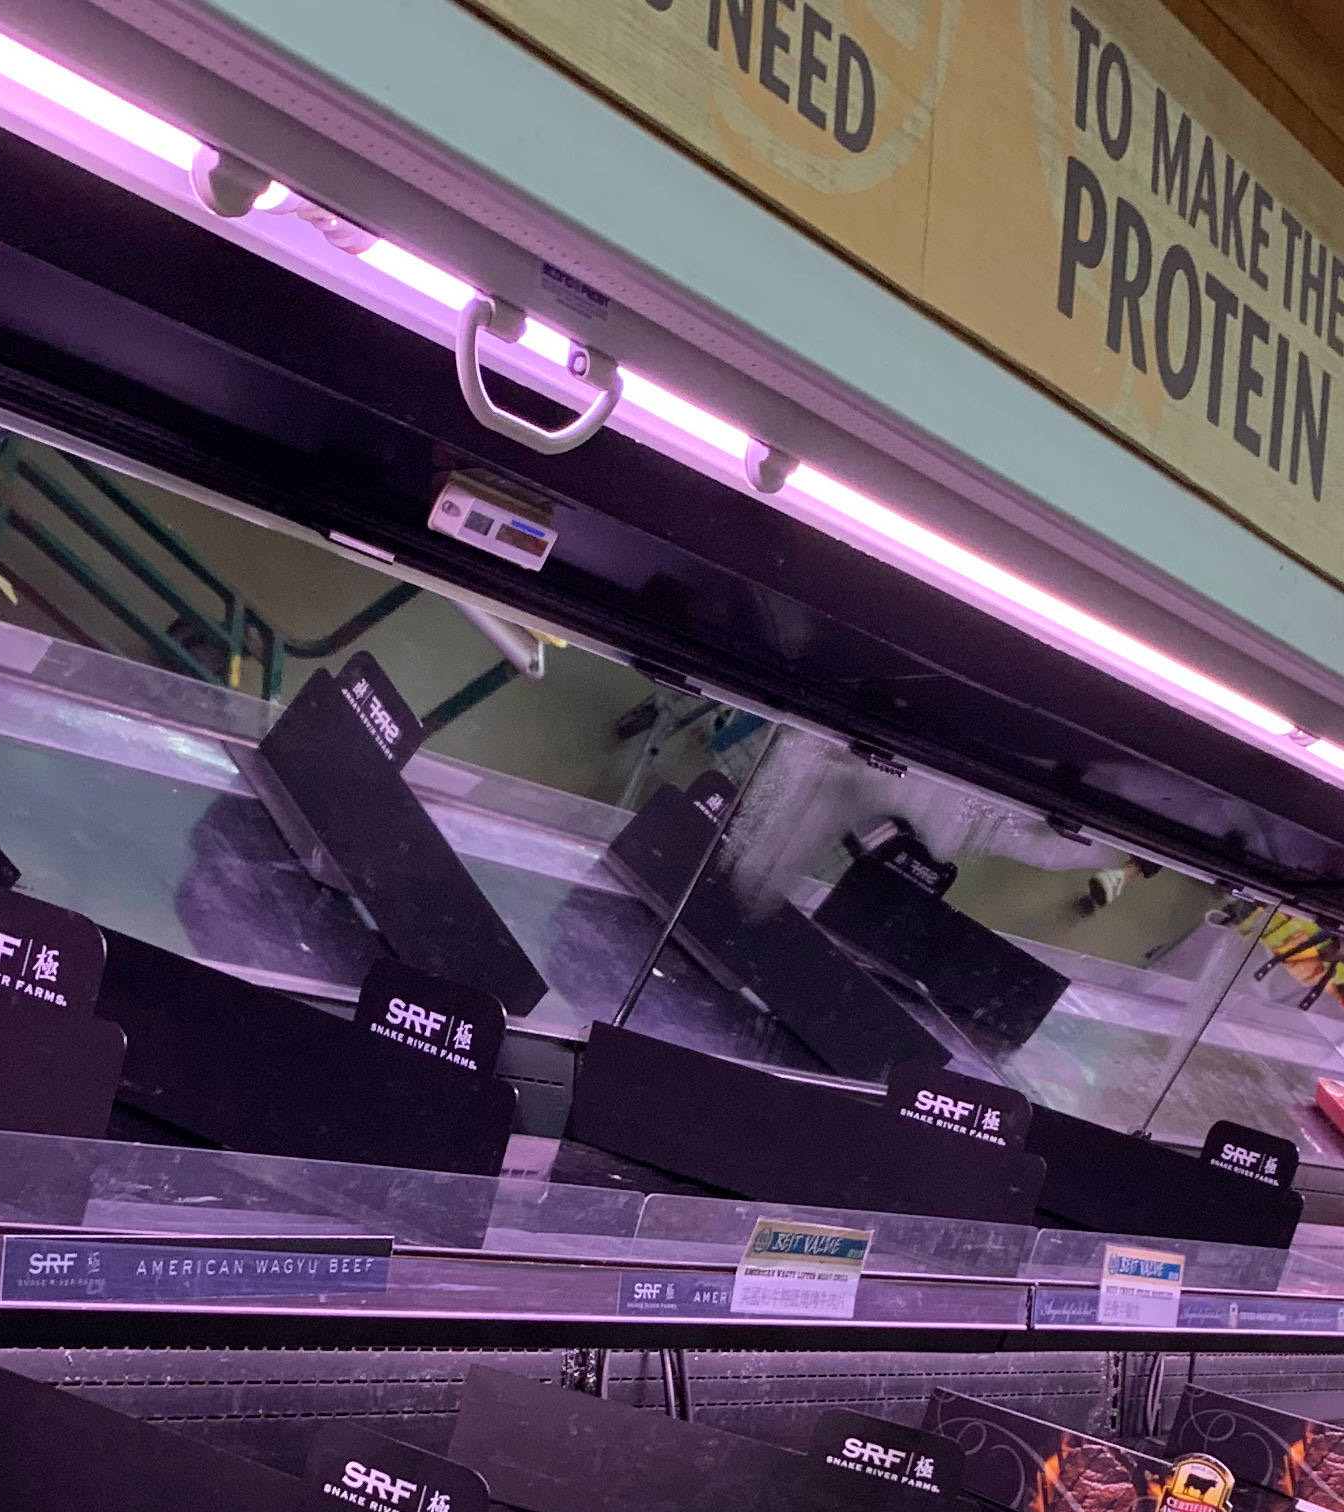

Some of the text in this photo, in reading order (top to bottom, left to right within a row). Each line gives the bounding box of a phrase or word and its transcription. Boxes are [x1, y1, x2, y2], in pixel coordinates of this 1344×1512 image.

[1069, 5, 1132, 162] TO
[1150, 87, 1274, 291] MAKE
[1056, 156, 1331, 502] PROTEIN
[386, 998, 446, 1037] SRF
[370, 1022, 404, 1043] SNAKE
[406, 1036, 438, 1055] RIVER
[900, 1108, 966, 1134] SNAKE RIVER
[913, 1090, 974, 1121] SRF
[1221, 1143, 1260, 1169] SRF
[28, 1252, 375, 1277] SRF AMERICAN WAGYU BEEF
[633, 1283, 662, 1300] SRF
[826, 1455, 863, 1472] SNAKE
[865, 1466, 898, 1482] RIVER
[842, 1438, 906, 1469] SRF
[323, 1483, 365, 1507] SNAKE
[342, 1461, 417, 1504] SRF
